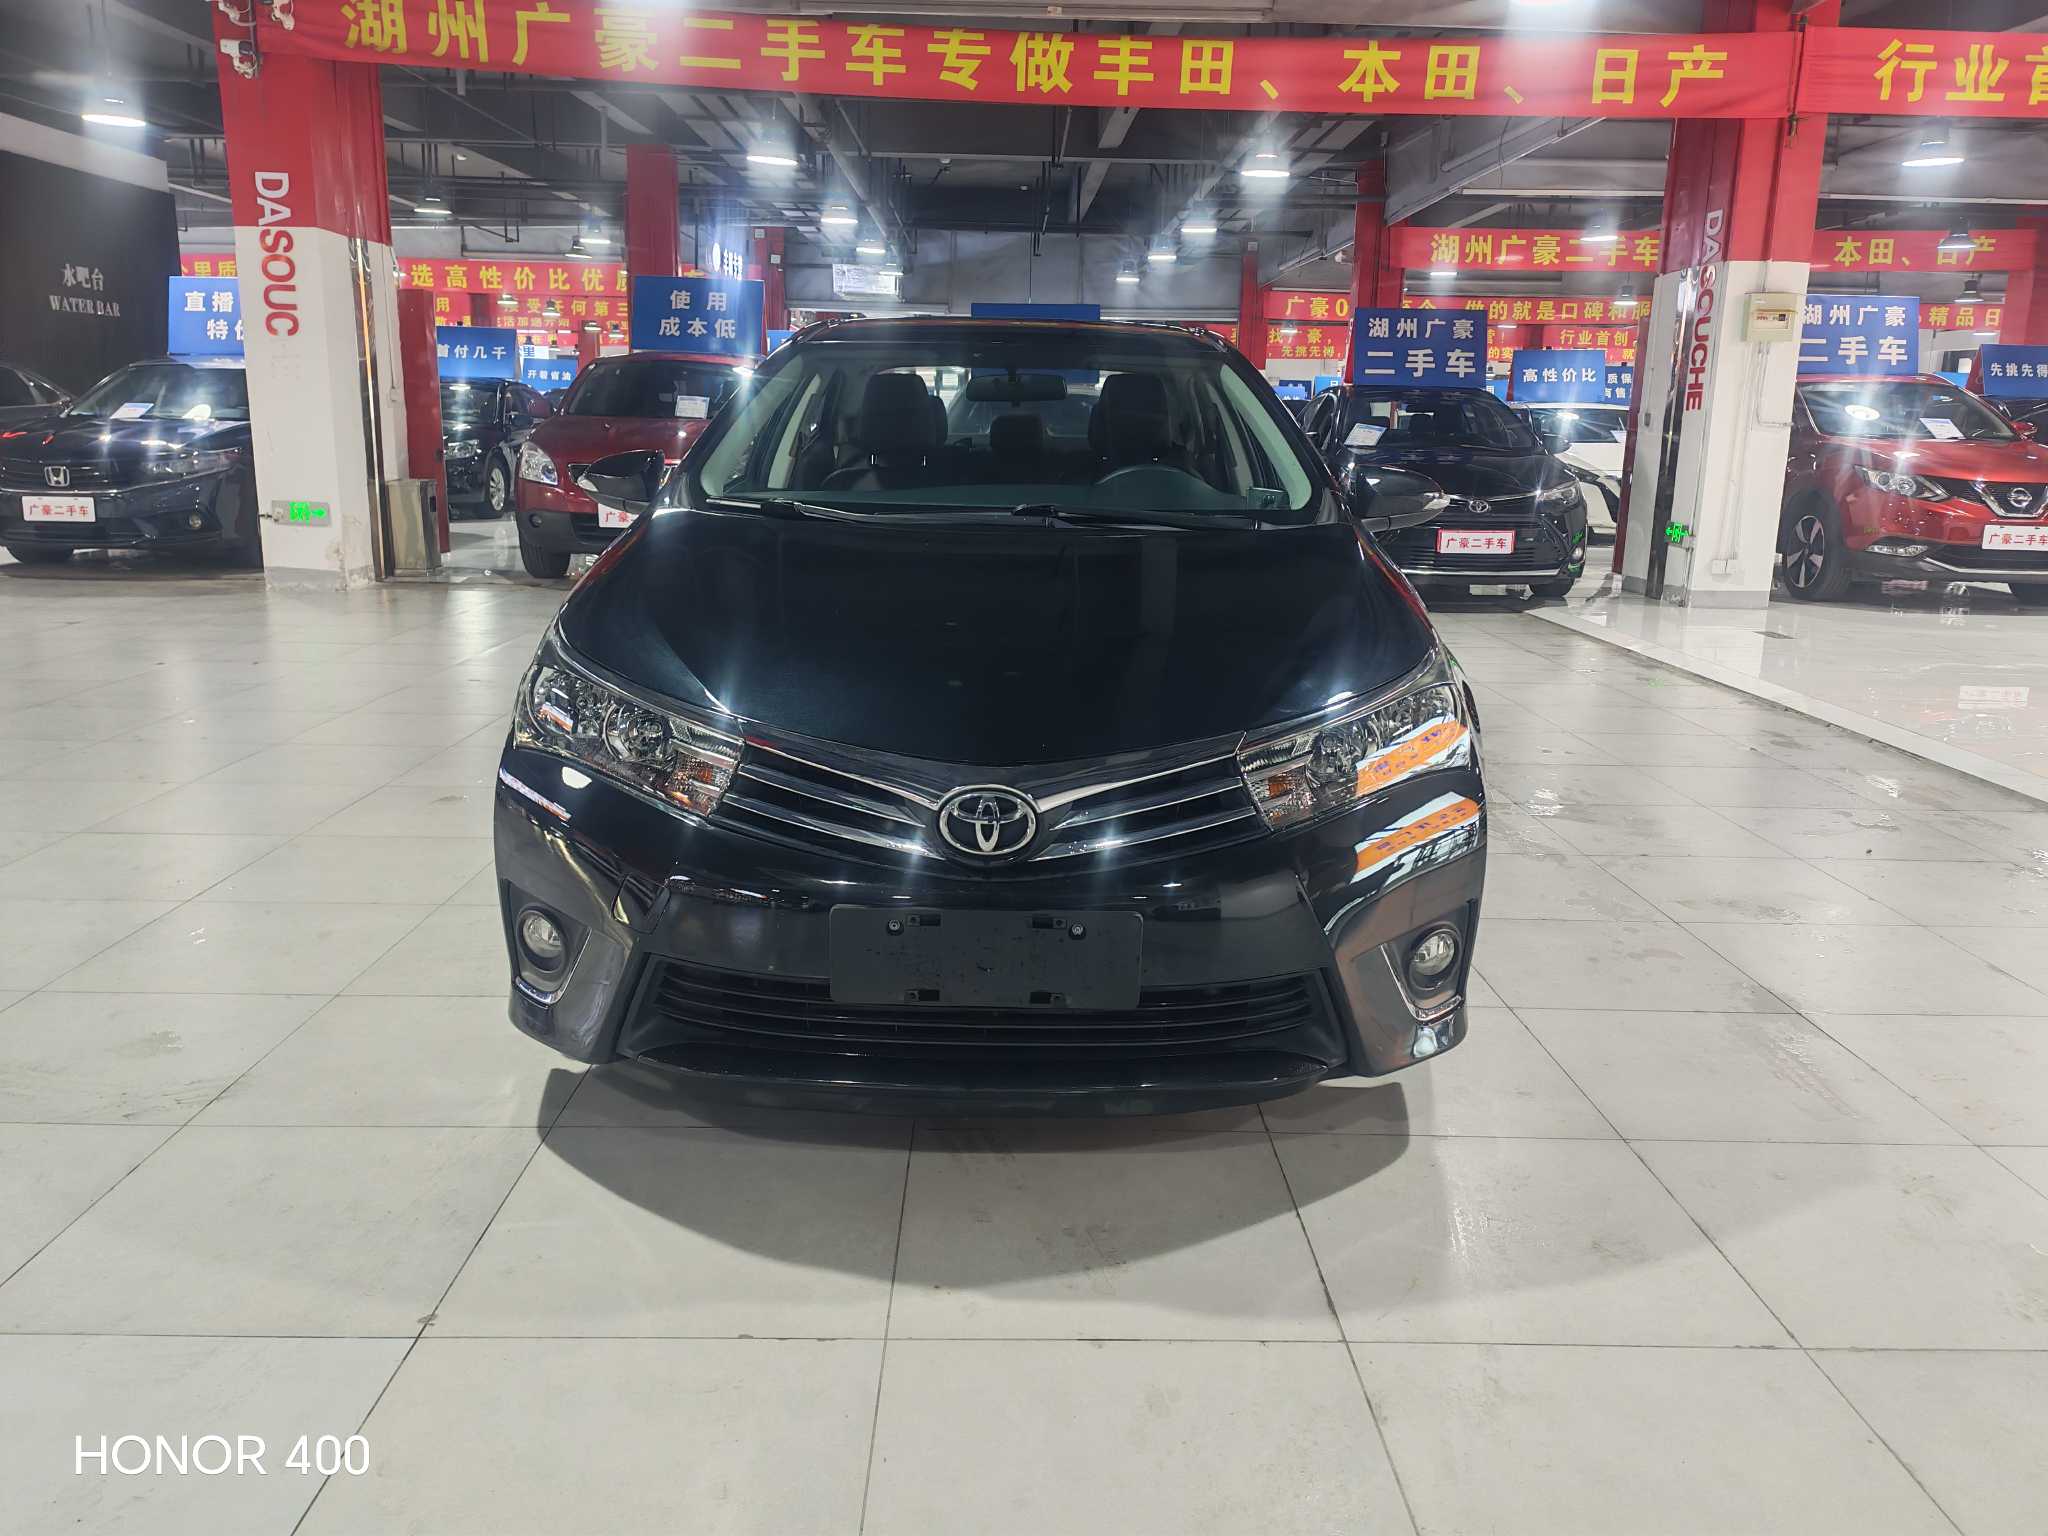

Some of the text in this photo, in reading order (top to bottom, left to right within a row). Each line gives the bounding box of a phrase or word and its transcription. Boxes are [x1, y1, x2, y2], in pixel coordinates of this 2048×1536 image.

[340, 0, 1729, 109] 湖州广豪二手车专做丰田、本田、日产
[254, 171, 300, 337] DASOUC
[1429, 232, 1660, 268] 湖州广豪二手车
[62, 263, 105, 292] 水吧台
[49, 294, 121, 318] WATER BAR
[184, 290, 235, 313] 直播
[670, 289, 728, 311] 使用
[1801, 303, 1906, 327] 湖州广豪
[658, 317, 736, 339] 成本低
[1368, 317, 1474, 340] 湖州广豪
[437, 343, 507, 361] 首付几千
[1798, 335, 1908, 366] 二手车
[1364, 348, 1477, 379] 二手车
[1522, 367, 1597, 383] 高性价比
[1991, 362, 2048, 379] 先挑先得
[28, 502, 90, 517] 广豪二手车
[1445, 536, 1508, 550] 广豪二手车
[1988, 533, 2048, 546] 广豪二手车
